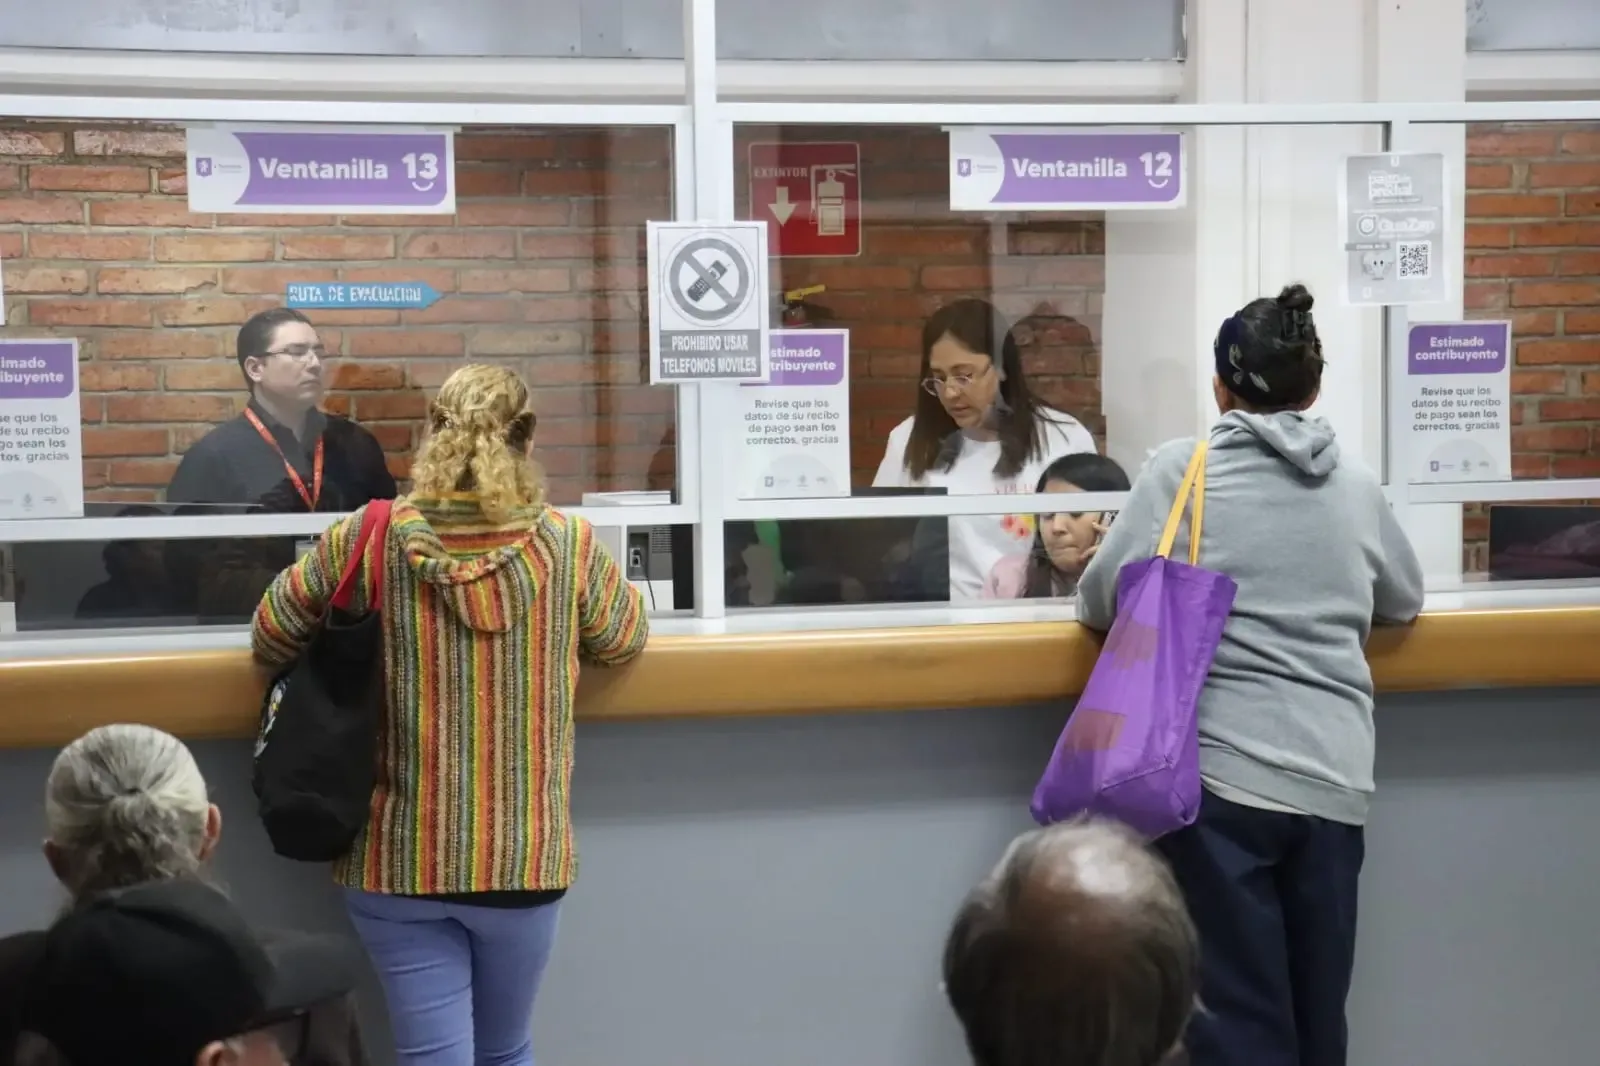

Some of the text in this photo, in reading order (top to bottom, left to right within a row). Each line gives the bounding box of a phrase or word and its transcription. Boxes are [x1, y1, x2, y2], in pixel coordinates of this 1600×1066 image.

[258, 157, 388, 180] Ventanilla
[401, 152, 439, 180] 13
[1011, 156, 1128, 178] Ventanilla
[1139, 151, 1173, 177] 12
[289, 285, 324, 302] RUTA
[328, 285, 344, 302] DE
[671, 334, 749, 351] PROHIBIDO USAR
[1430, 336, 1485, 348] Estimado
[770, 346, 821, 358] stimado
[1415, 349, 1499, 362] contribuyente
[0, 356, 46, 369] imado
[663, 356, 757, 374] TELEFONOS MOVILES
[770, 360, 837, 373] tribuyente
[0, 370, 64, 386] ibuyente
[1421, 385, 1491, 397] Revise que los
[754, 399, 829, 410] Revise que los
[1411, 398, 1501, 408] datos de su recibo
[14, 414, 37, 425] que
[40, 412, 58, 422] los
[744, 411, 840, 421] datos de su recibo
[1415, 409, 1498, 421] de pago sean los
[15, 427, 28, 435] su
[32, 425, 70, 435] recibo
[748, 423, 836, 434] de pago sean los
[1465, 421, 1500, 432] gracias
[0, 438, 66, 451] go sean los
[801, 434, 839, 446] gracias
[26, 452, 70, 463] gracias
